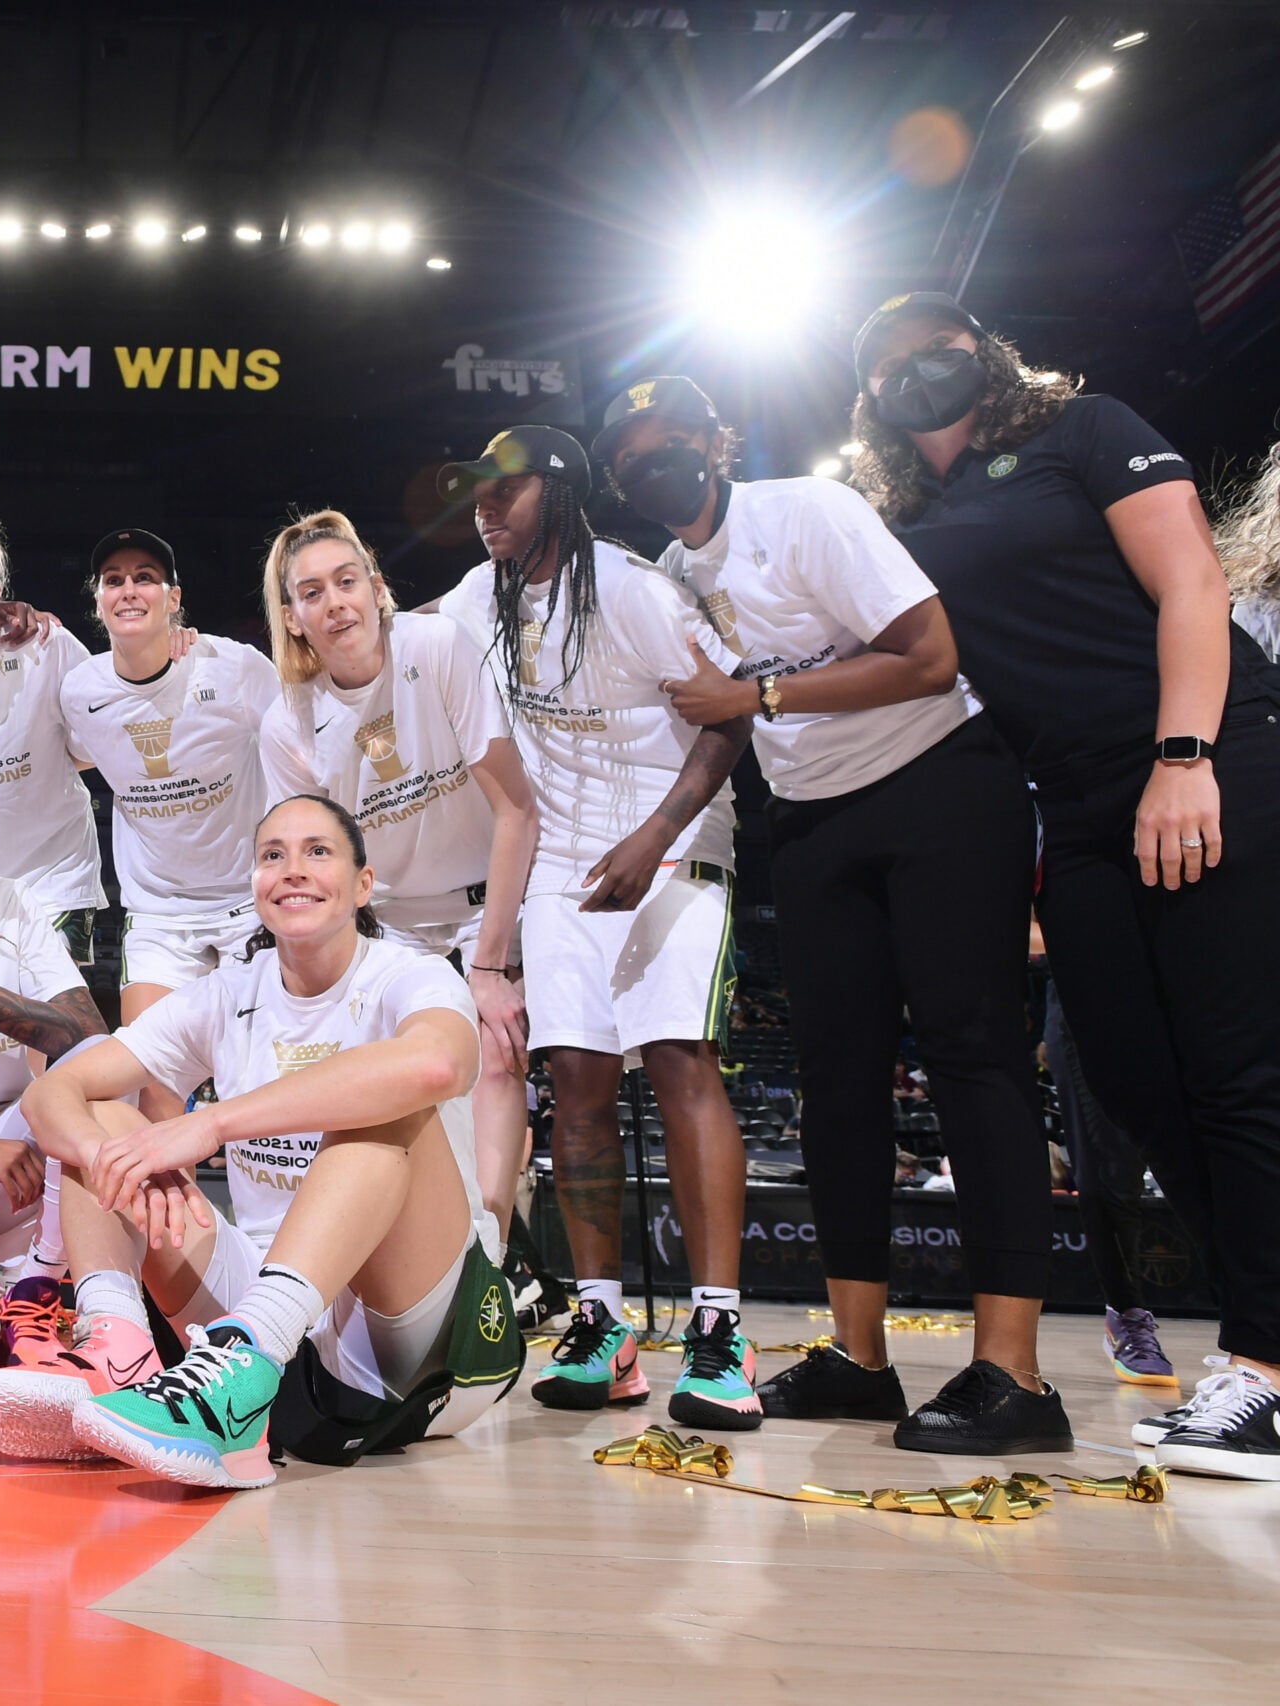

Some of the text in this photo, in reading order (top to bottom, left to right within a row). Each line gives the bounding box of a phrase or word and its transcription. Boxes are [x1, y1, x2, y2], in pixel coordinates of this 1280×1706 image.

[114, 346, 281, 390] WINS
[440, 343, 566, 396] fry's
[742, 655, 785, 676] WNBA
[798, 644, 835, 669] CUP
[525, 691, 561, 705] WNBA
[570, 708, 602, 717] CUP
[5, 752, 31, 766] CUP
[436, 760, 464, 779] CUP
[129, 778, 200, 793] 2021 WNBA
[209, 773, 233, 791] CUP
[362, 787, 394, 806] 2021
[249, 1138, 294, 1150] 2021
